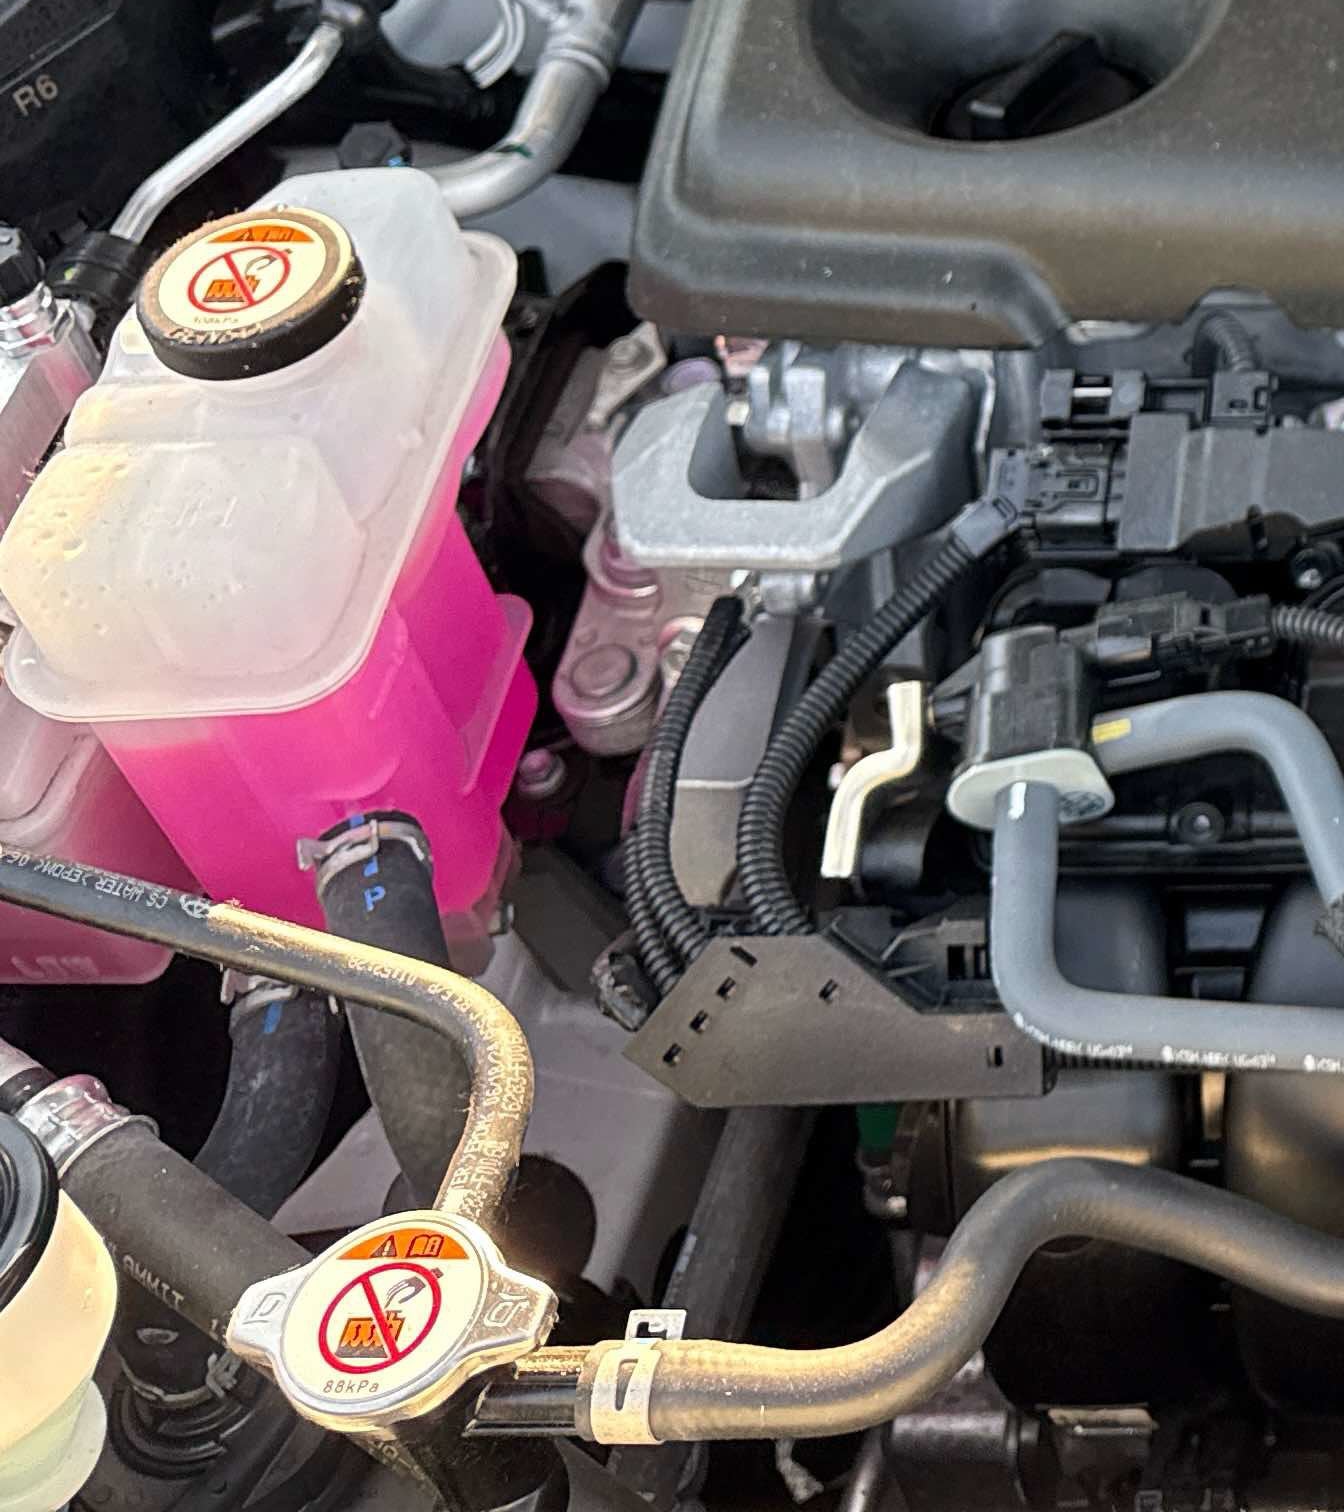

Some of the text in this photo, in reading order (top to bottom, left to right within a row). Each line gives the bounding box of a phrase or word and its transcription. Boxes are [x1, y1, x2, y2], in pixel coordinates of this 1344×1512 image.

[12, 74, 58, 117] R6
[95, 877, 145, 903] WATER
[146, 891, 169, 909] CS
[364, 886, 386, 911] P
[322, 1379, 380, 1394] 88kPa
